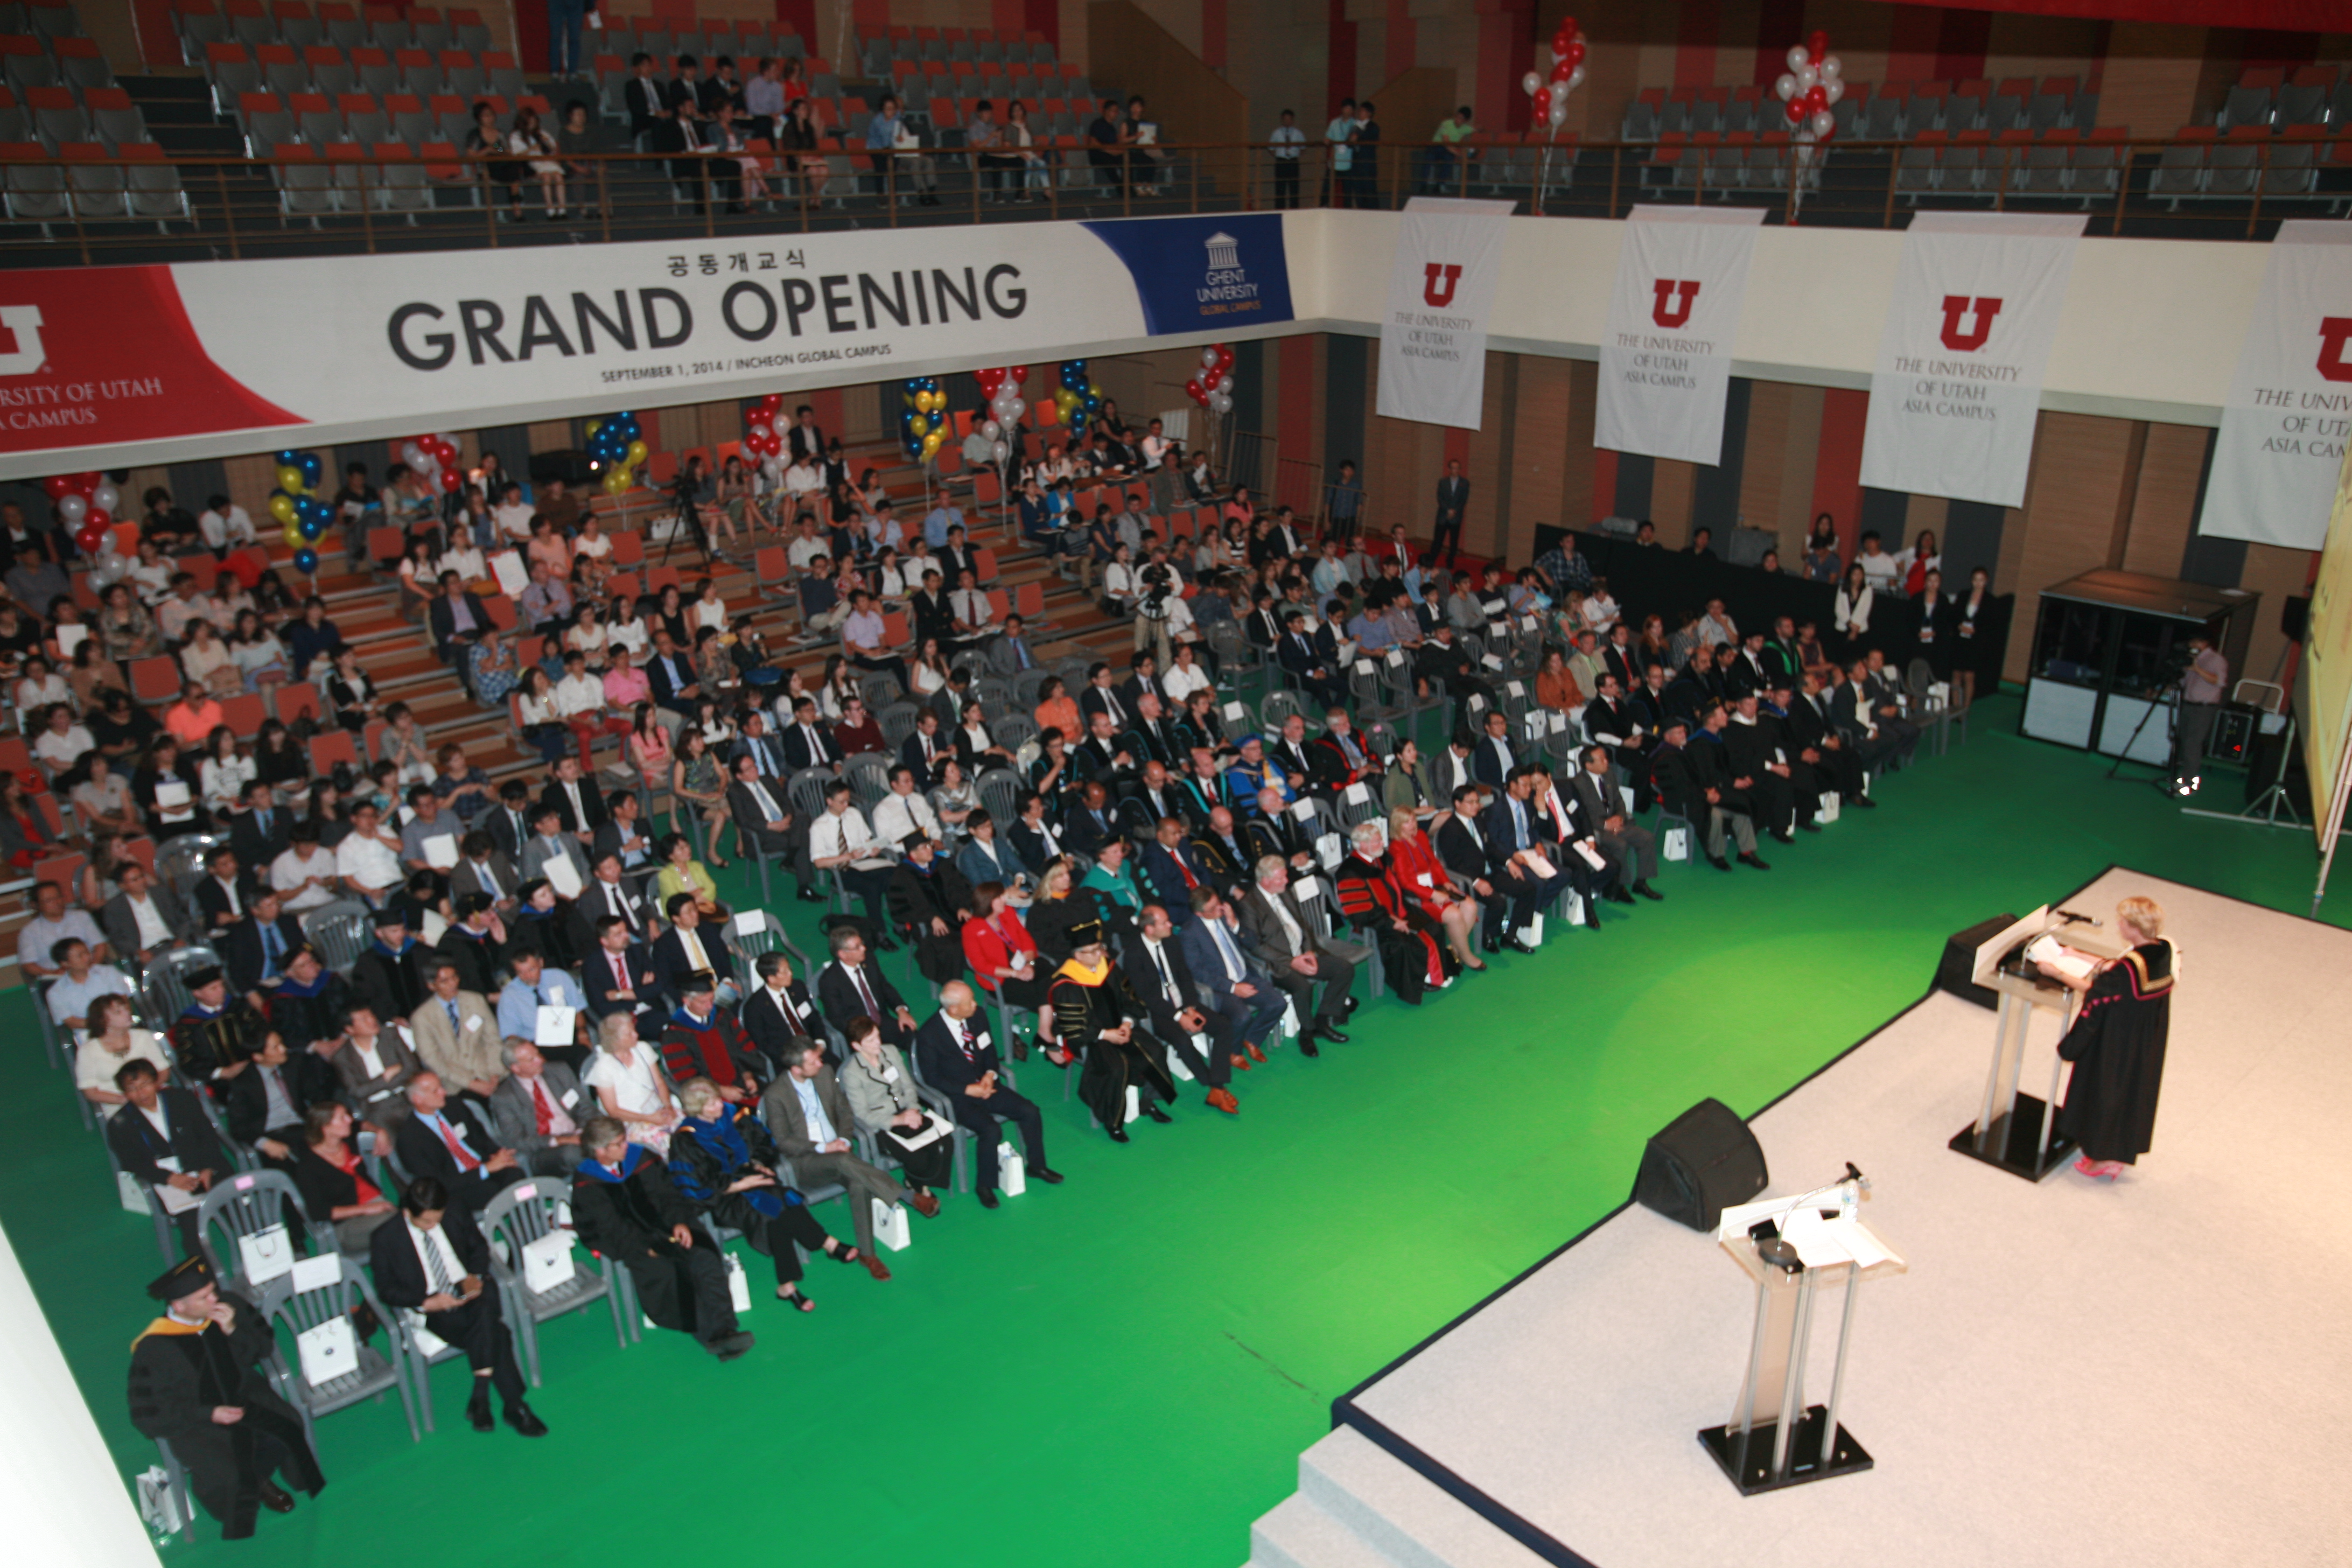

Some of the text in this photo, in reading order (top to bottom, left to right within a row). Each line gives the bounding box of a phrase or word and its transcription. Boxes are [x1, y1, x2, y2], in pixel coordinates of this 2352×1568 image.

[1205, 269, 1245, 286] GHENT
[1424, 262, 1463, 308] U
[1196, 283, 1258, 303] UNIVERSITY
[1199, 300, 1261, 316] GLOBAL CAMPUS
[1652, 278, 1702, 329] U
[388, 264, 1027, 372] GRAND OPENING
[1396, 312, 1473, 331] THE UNIVERSITY
[1940, 295, 2003, 353] U
[1408, 330, 1453, 346] OF UTAH
[1618, 333, 1714, 355] THE UNIVERSITY
[601, 366, 674, 382] SEPTEMBER
[677, 365, 690, 377] 1,
[692, 361, 723, 374] 2014
[736, 353, 794, 370] INCHEON
[797, 349, 843, 363] GLOBAL
[845, 344, 892, 358] CAMPUS
[1401, 345, 1460, 362] ASIA CAMPUS
[1634, 354, 1689, 372] OF UTAH
[1895, 356, 2022, 382] THE UNIVERSITY
[66, 382, 96, 402] OF
[100, 377, 163, 400] UTAH
[1625, 370, 1696, 390] ASIA CAMPUS
[1915, 380, 1986, 401] OF UTAH
[2254, 388, 2293, 408] THE
[9, 405, 98, 430] CAMPUS
[1902, 398, 1997, 421] ASIA CAMPUS
[2282, 415, 2311, 433] OF
[2260, 436, 2301, 455] ASIA
